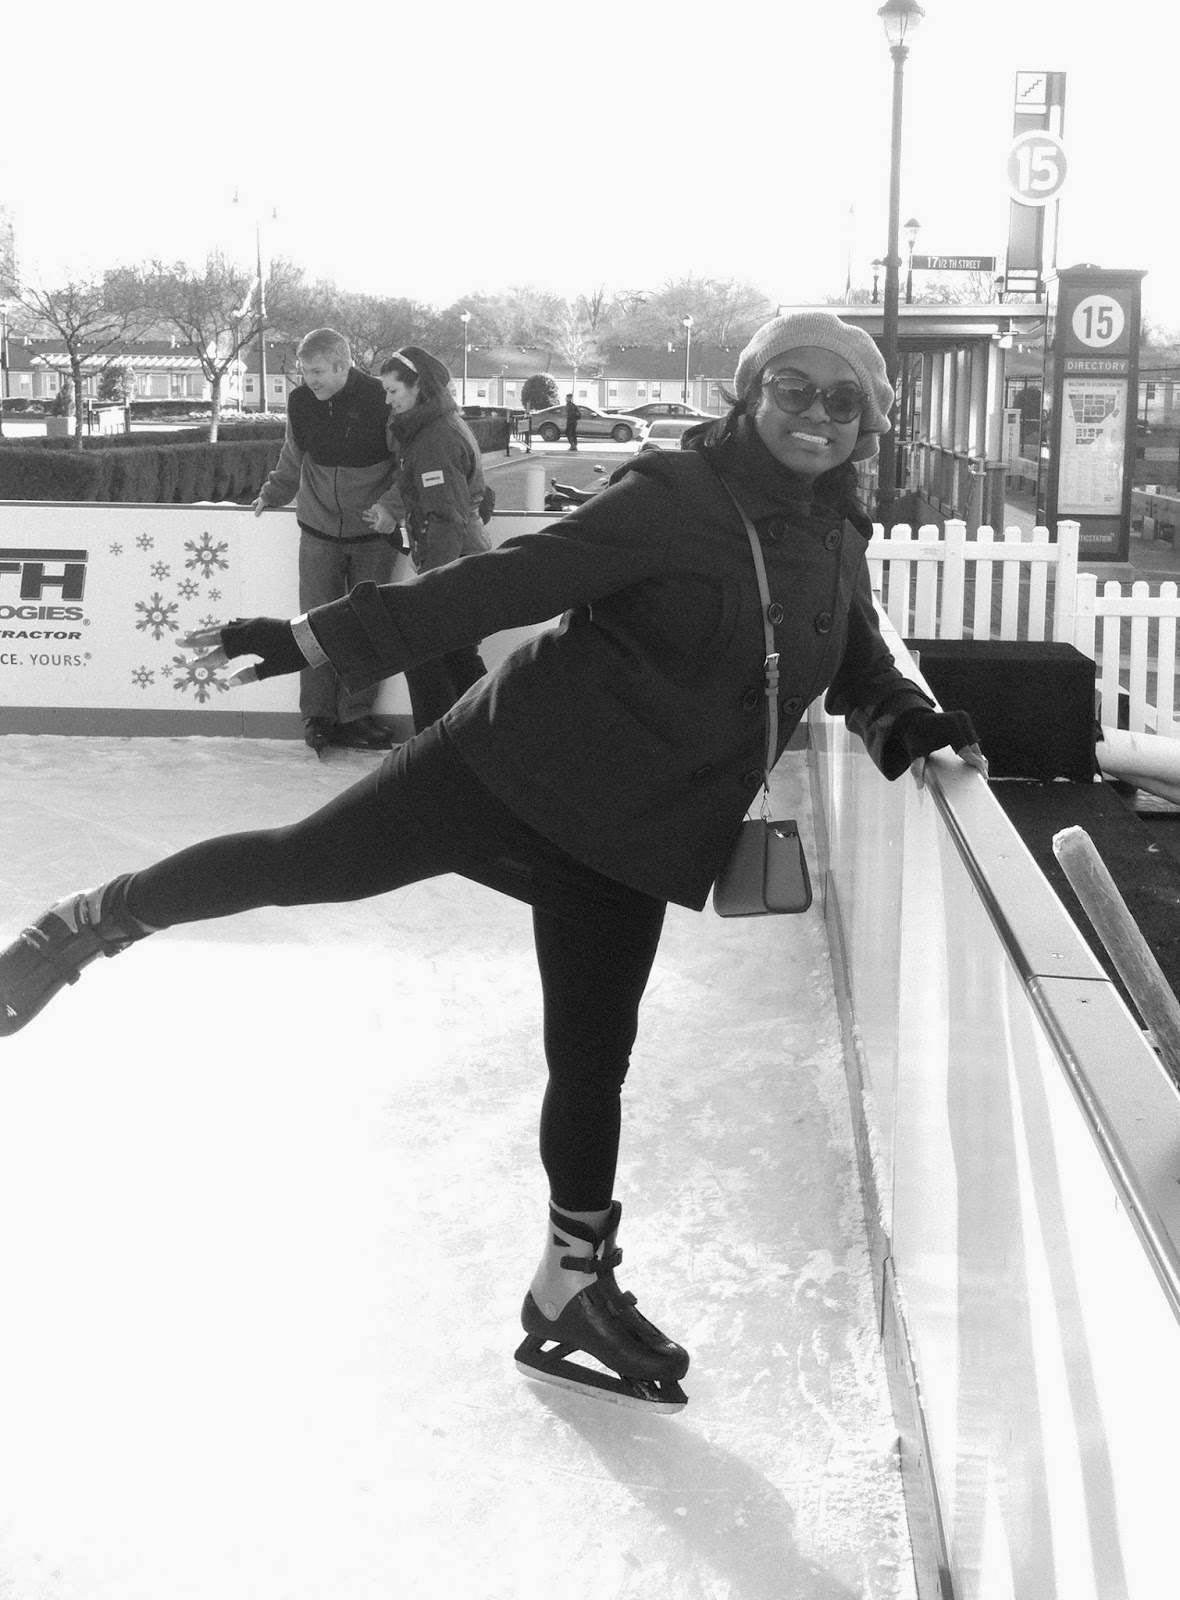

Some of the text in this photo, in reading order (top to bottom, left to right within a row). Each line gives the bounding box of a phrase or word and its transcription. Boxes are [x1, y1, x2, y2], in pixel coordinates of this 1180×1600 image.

[1016, 146, 1059, 191] 15
[958, 259, 981, 269] STREET
[1082, 305, 1114, 339] 15
[1067, 361, 1126, 371] DIRECTORY
[0, 630, 83, 639] RACTOR
